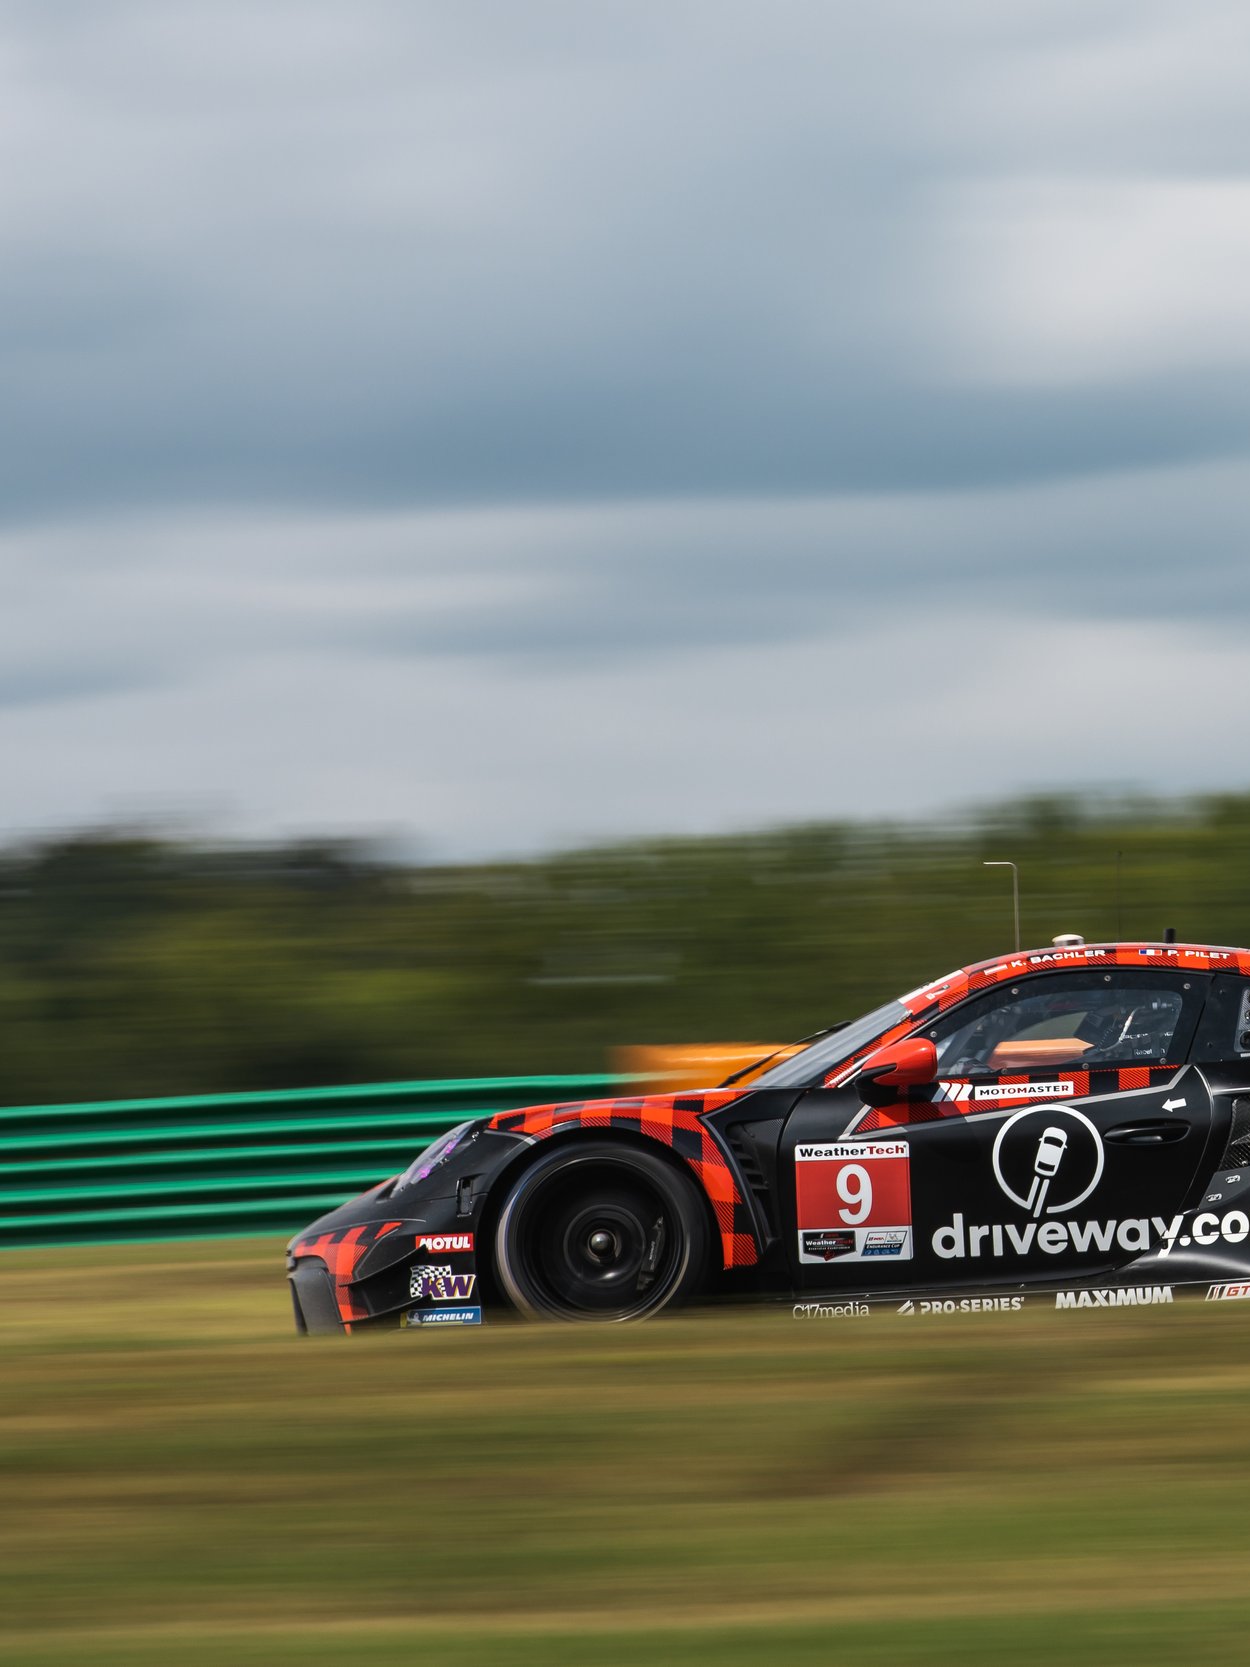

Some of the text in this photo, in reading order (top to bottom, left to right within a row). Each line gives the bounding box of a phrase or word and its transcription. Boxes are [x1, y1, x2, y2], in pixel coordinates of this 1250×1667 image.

[1011, 949, 1106, 968] K. BACHLER
[1185, 950, 1230, 960] PILET
[979, 1084, 1070, 1097] MOTOMASTER
[799, 1144, 906, 1158] WeatherTech
[836, 1163, 873, 1226] 9
[419, 1236, 471, 1251] MOTUL
[421, 1275, 474, 1298] KW
[1055, 1286, 1174, 1309] MAXIMUM
[422, 1312, 474, 1322] MICHELIN
[792, 1302, 870, 1320] C17media
